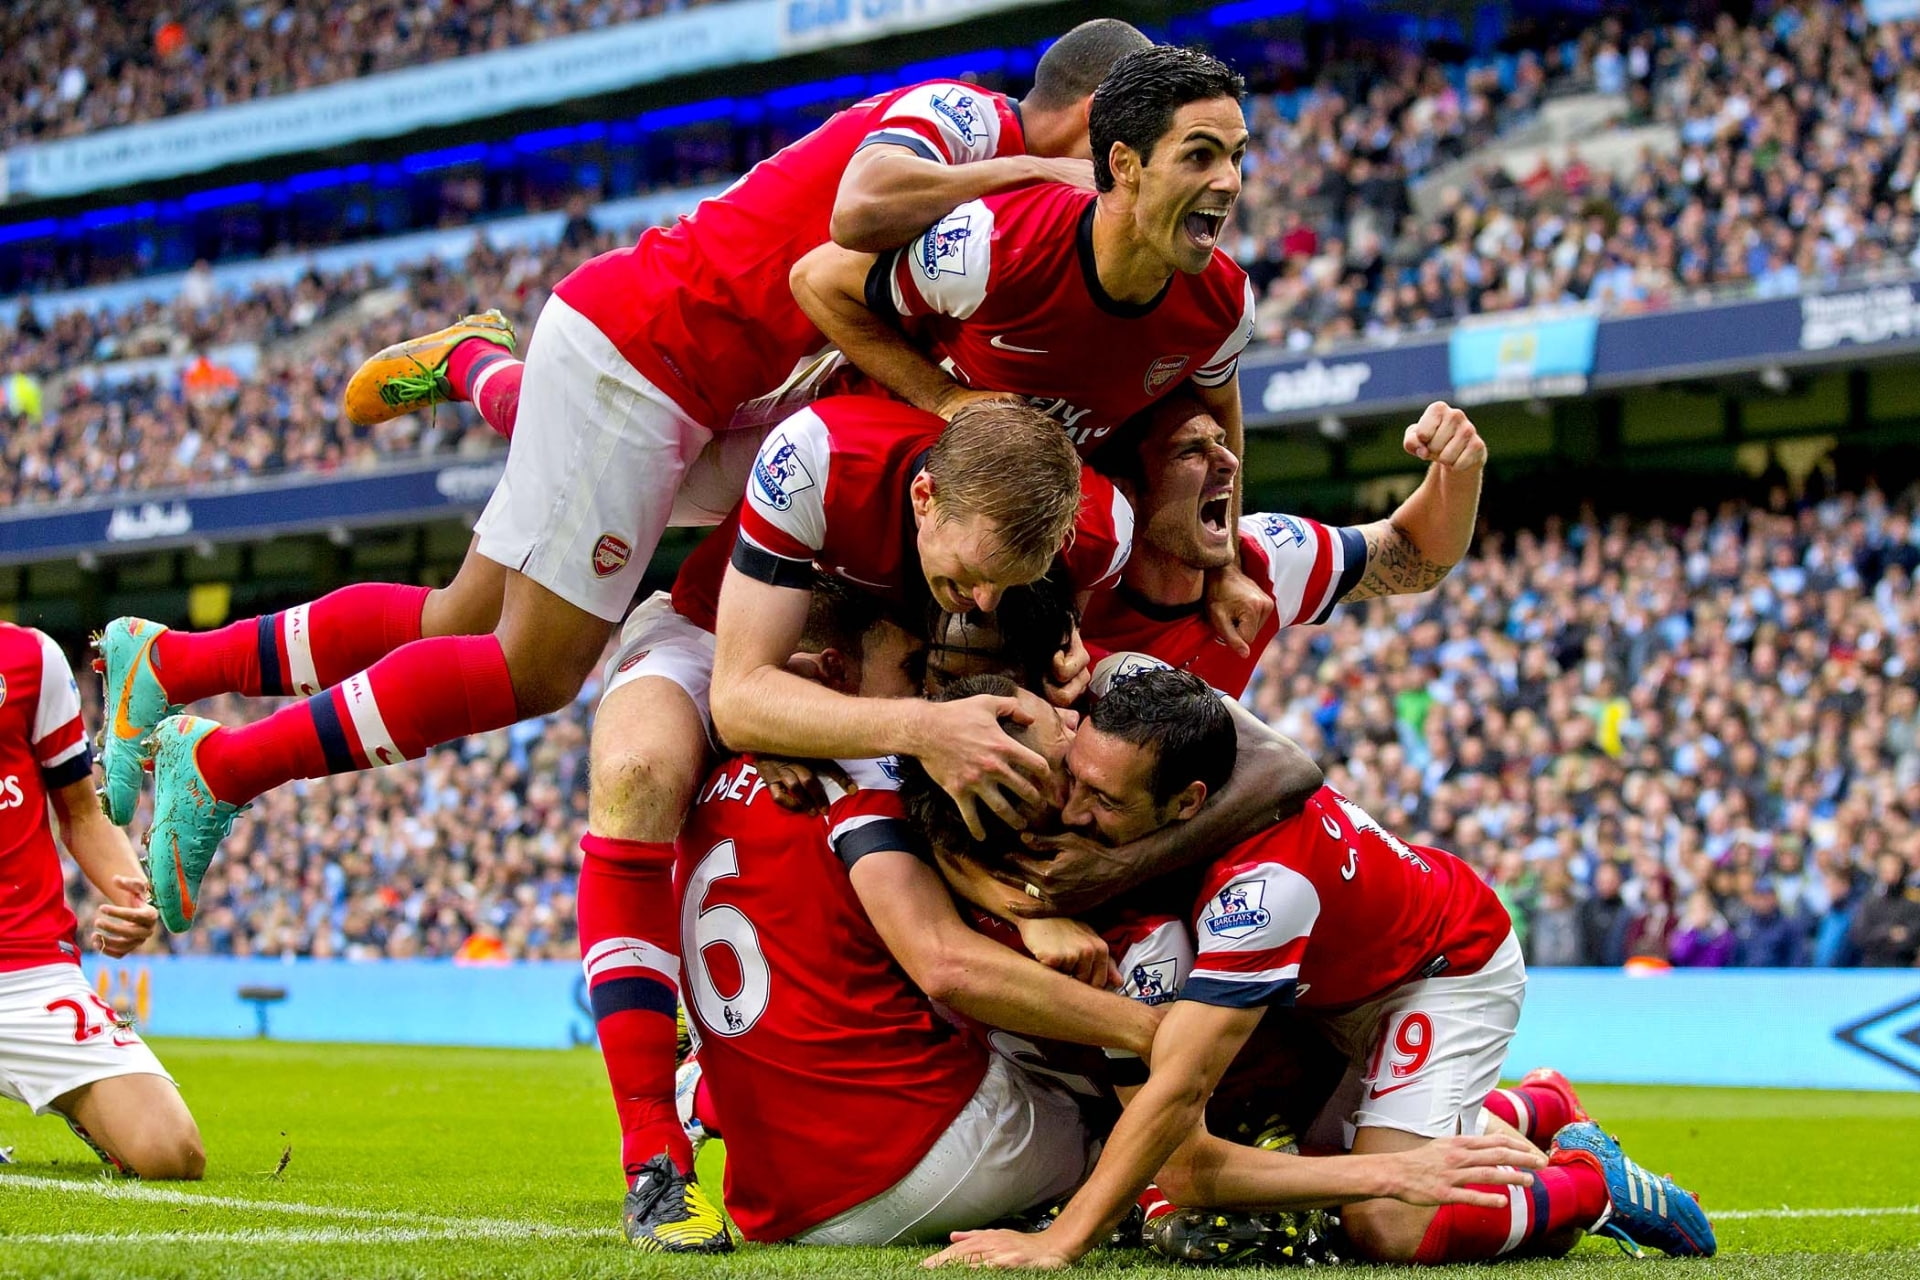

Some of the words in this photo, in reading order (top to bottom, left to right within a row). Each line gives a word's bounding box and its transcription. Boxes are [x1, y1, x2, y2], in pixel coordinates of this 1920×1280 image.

[602, 538, 628, 557] Arsenal
[679, 838, 770, 1037] 6
[1214, 913, 1252, 927] BARCLAYS
[1363, 1010, 1434, 1081] 19
